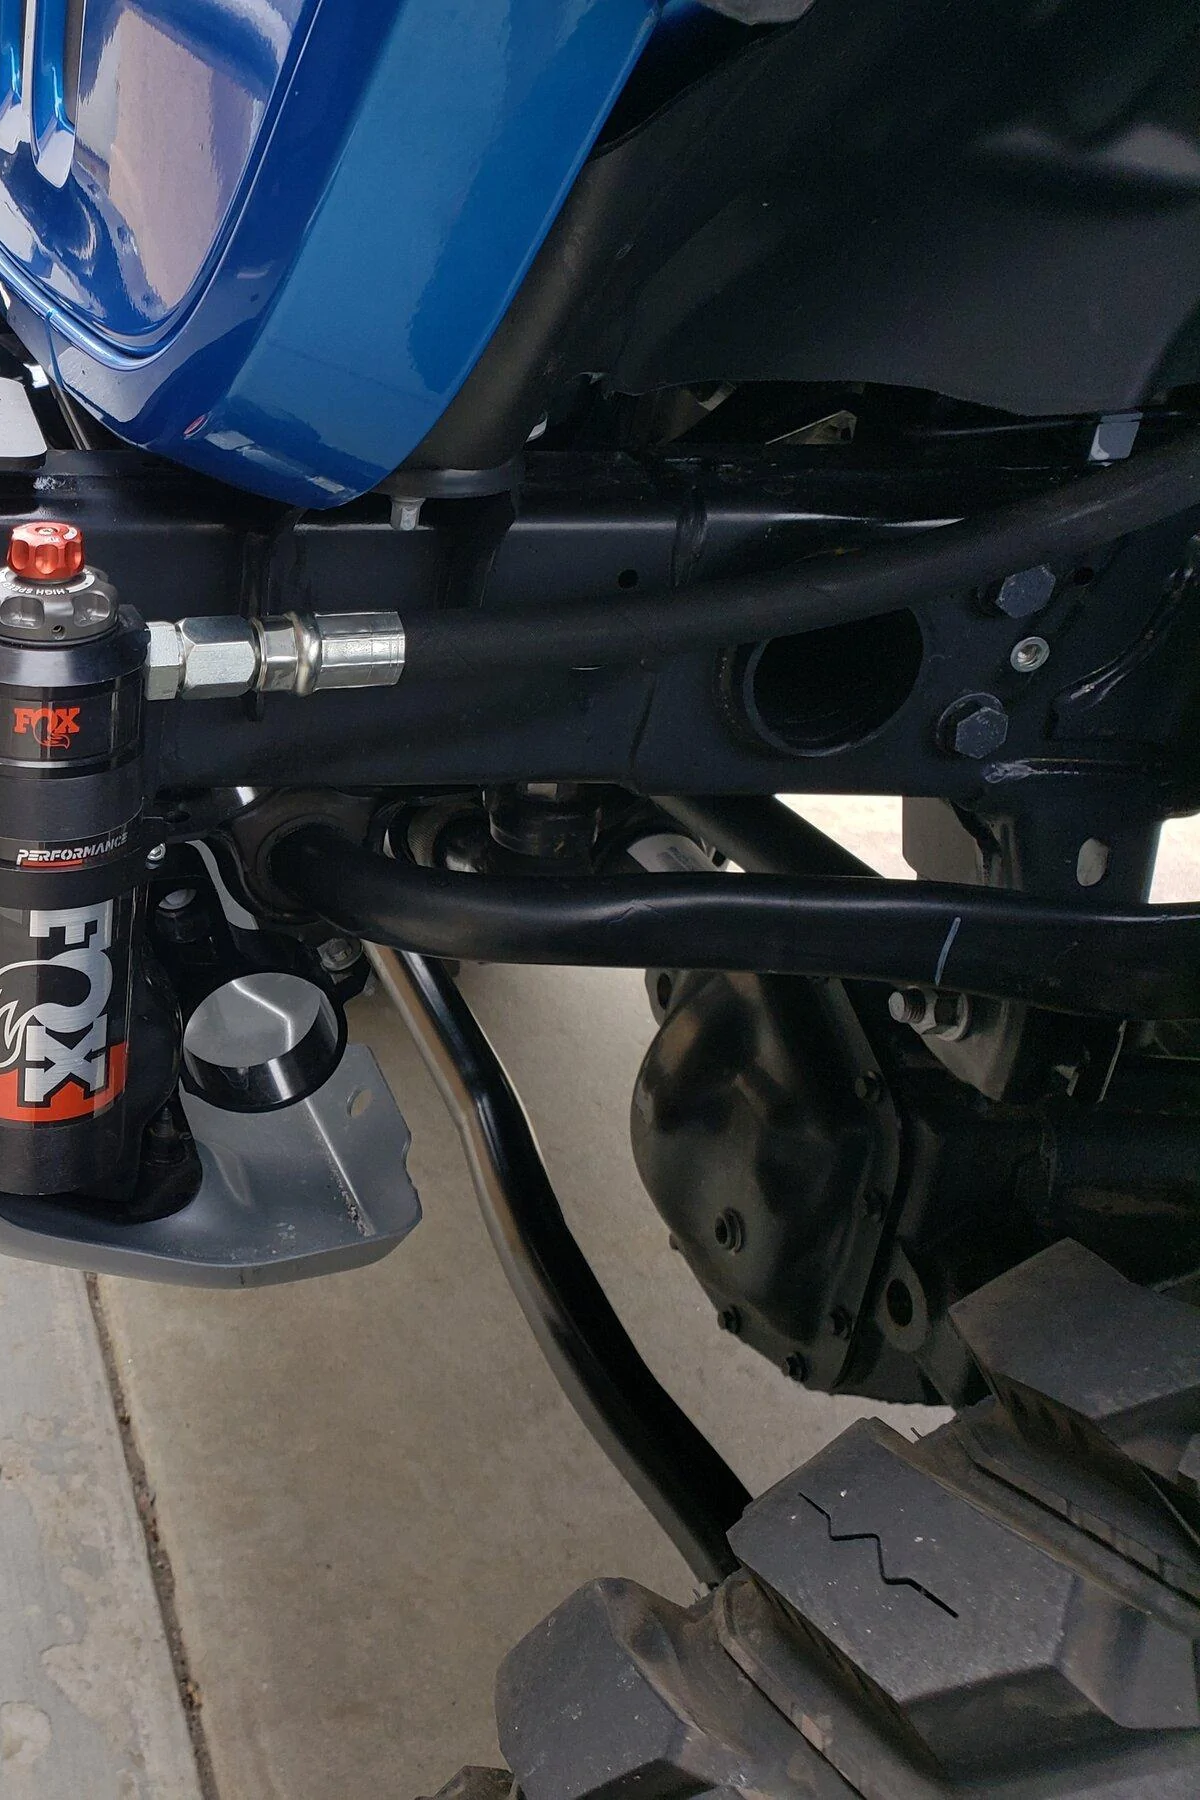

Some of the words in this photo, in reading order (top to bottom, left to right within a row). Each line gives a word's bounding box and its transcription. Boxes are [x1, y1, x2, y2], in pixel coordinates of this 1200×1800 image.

[2, 582, 33, 594] SPEED
[36, 588, 65, 596] HIGH
[13, 708, 81, 749] FOX
[16, 832, 128, 865] PERFORMANCE
